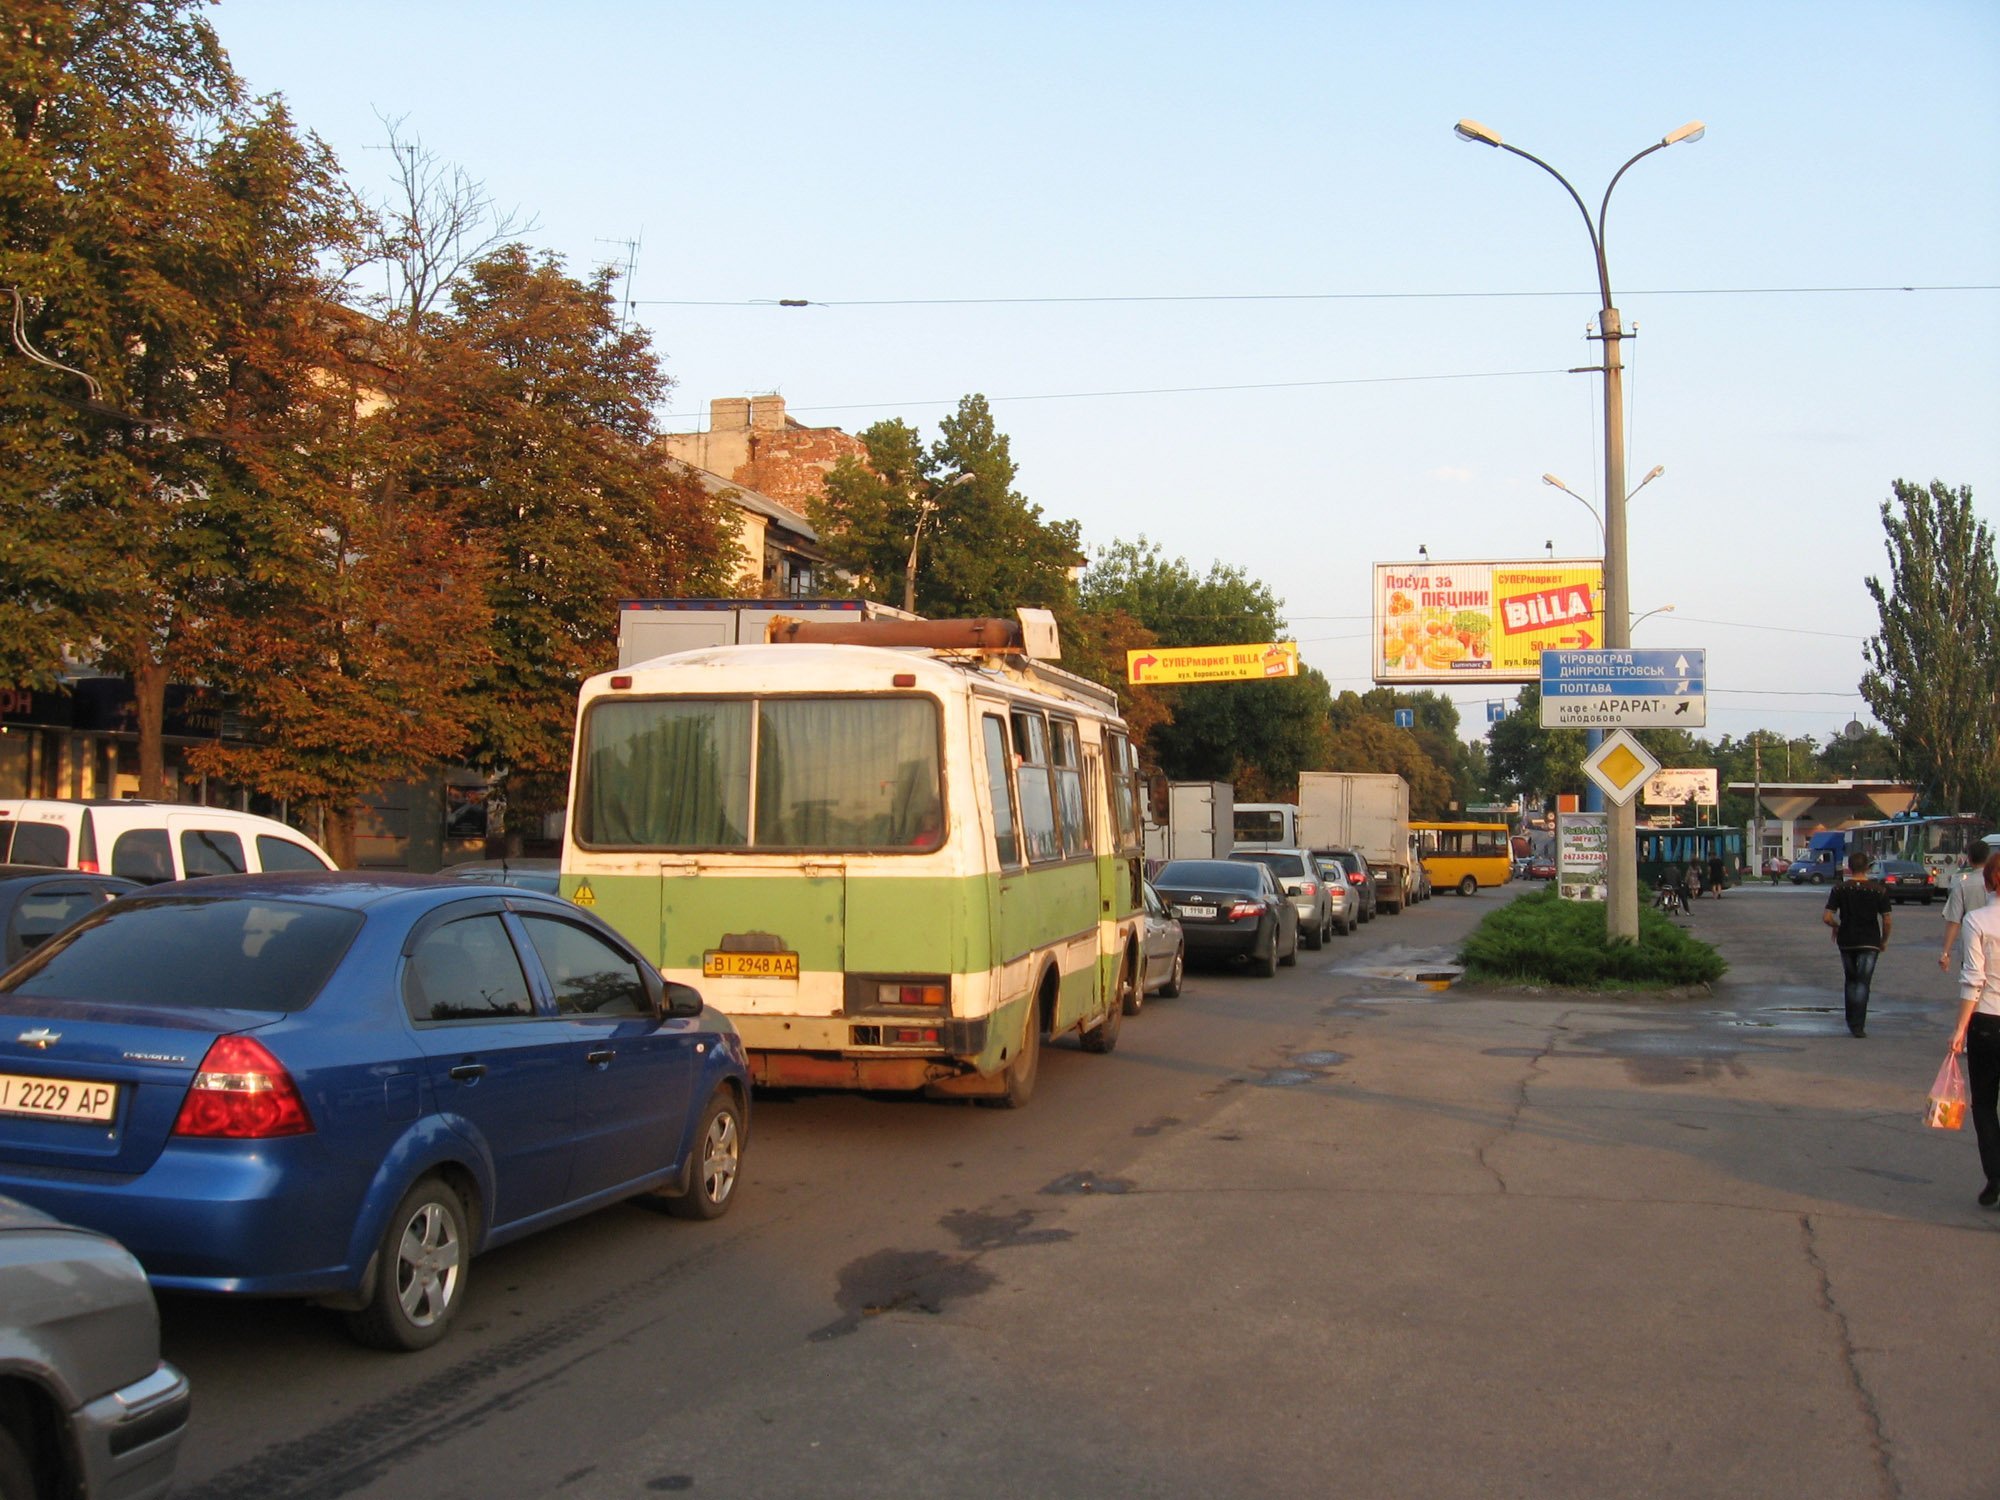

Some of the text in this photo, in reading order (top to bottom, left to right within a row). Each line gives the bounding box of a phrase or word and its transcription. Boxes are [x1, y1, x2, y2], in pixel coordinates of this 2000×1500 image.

[1387, 575, 1453, 590] Посуд за
[1498, 574, 1563, 585] СУПЕРмаркет
[1505, 591, 1588, 629] BILLA
[1531, 641, 1544, 651] 50
[1162, 653, 1259, 669] СУПЕРмаркет BILLA
[1559, 683, 1612, 694] ПОЛТАВА
[1560, 704, 1588, 715] кафе
[1560, 714, 1622, 724] цілодобово
[714, 957, 794, 973] BI 2948 AA
[18, 1082, 70, 1111] 2229
[77, 1087, 109, 1114] AP
